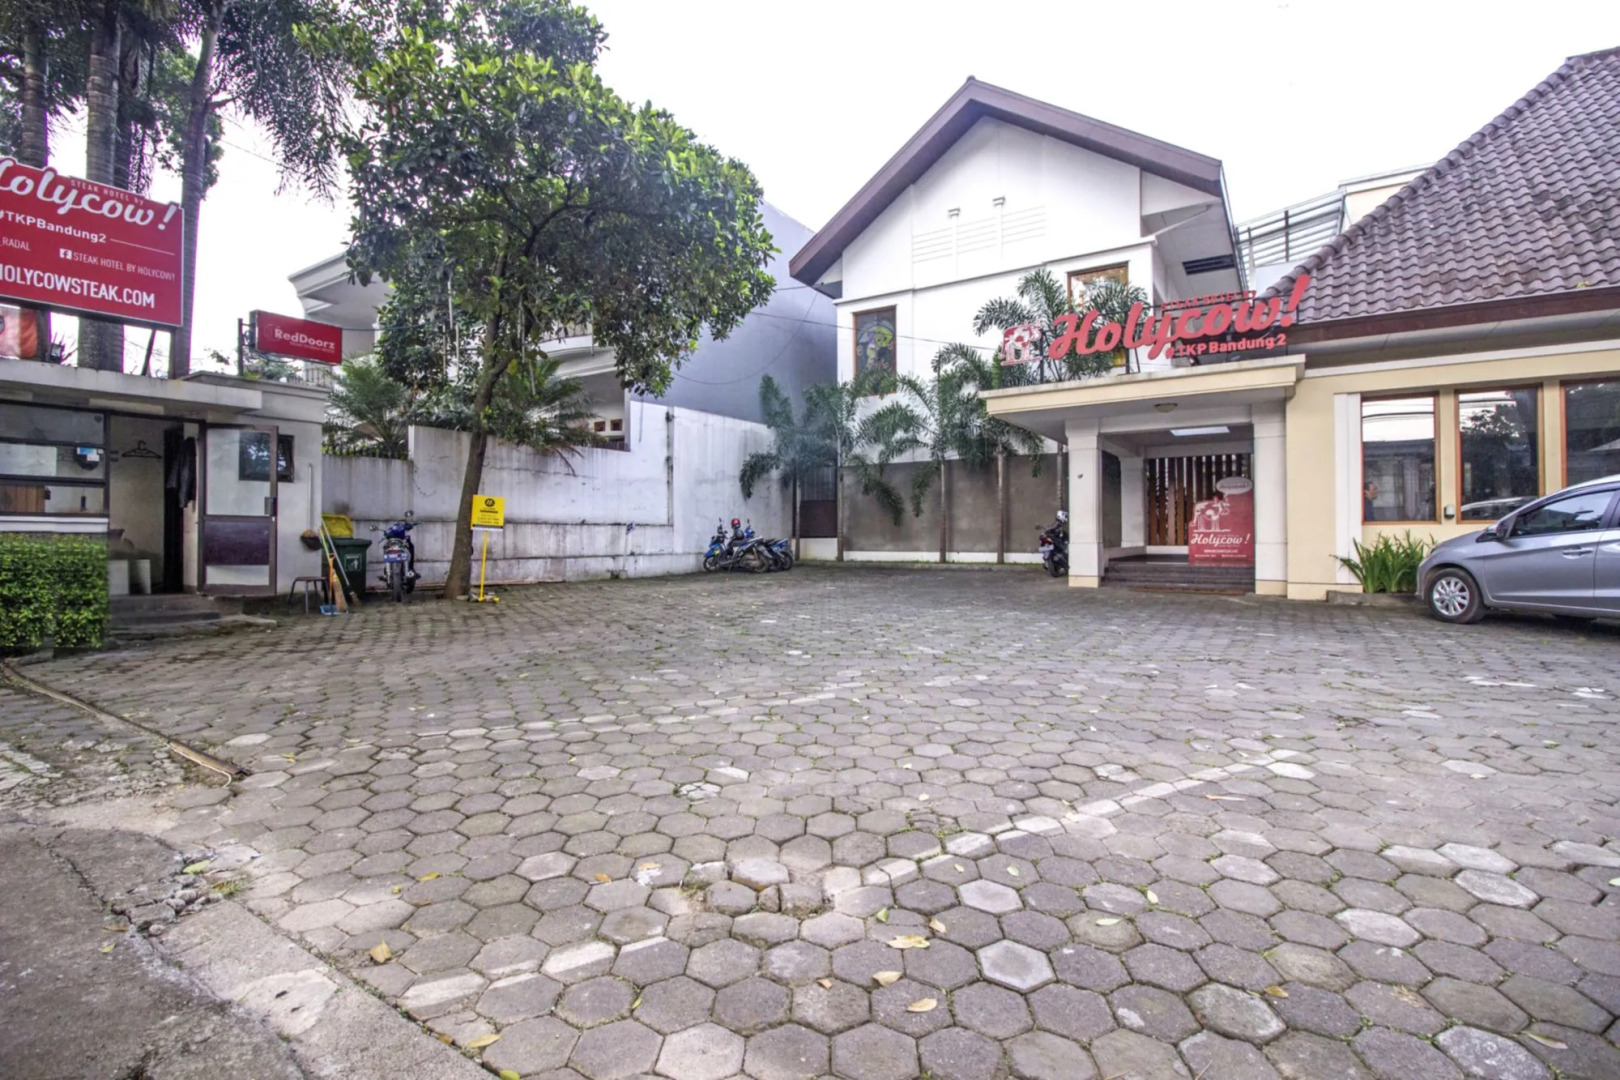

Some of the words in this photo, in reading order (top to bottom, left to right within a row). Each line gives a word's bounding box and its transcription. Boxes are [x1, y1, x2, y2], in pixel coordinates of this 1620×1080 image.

[73, 252, 98, 265] STEAK
[100, 258, 124, 271] HOTEL
[126, 263, 136, 272] BY
[1048, 274, 1310, 360] Holycow!
[274, 328, 335, 350] RedDoorz
[1209, 337, 1275, 354] Bandung
[1277, 333, 1286, 346] 2
[1190, 532, 1250, 547] Holycow!
